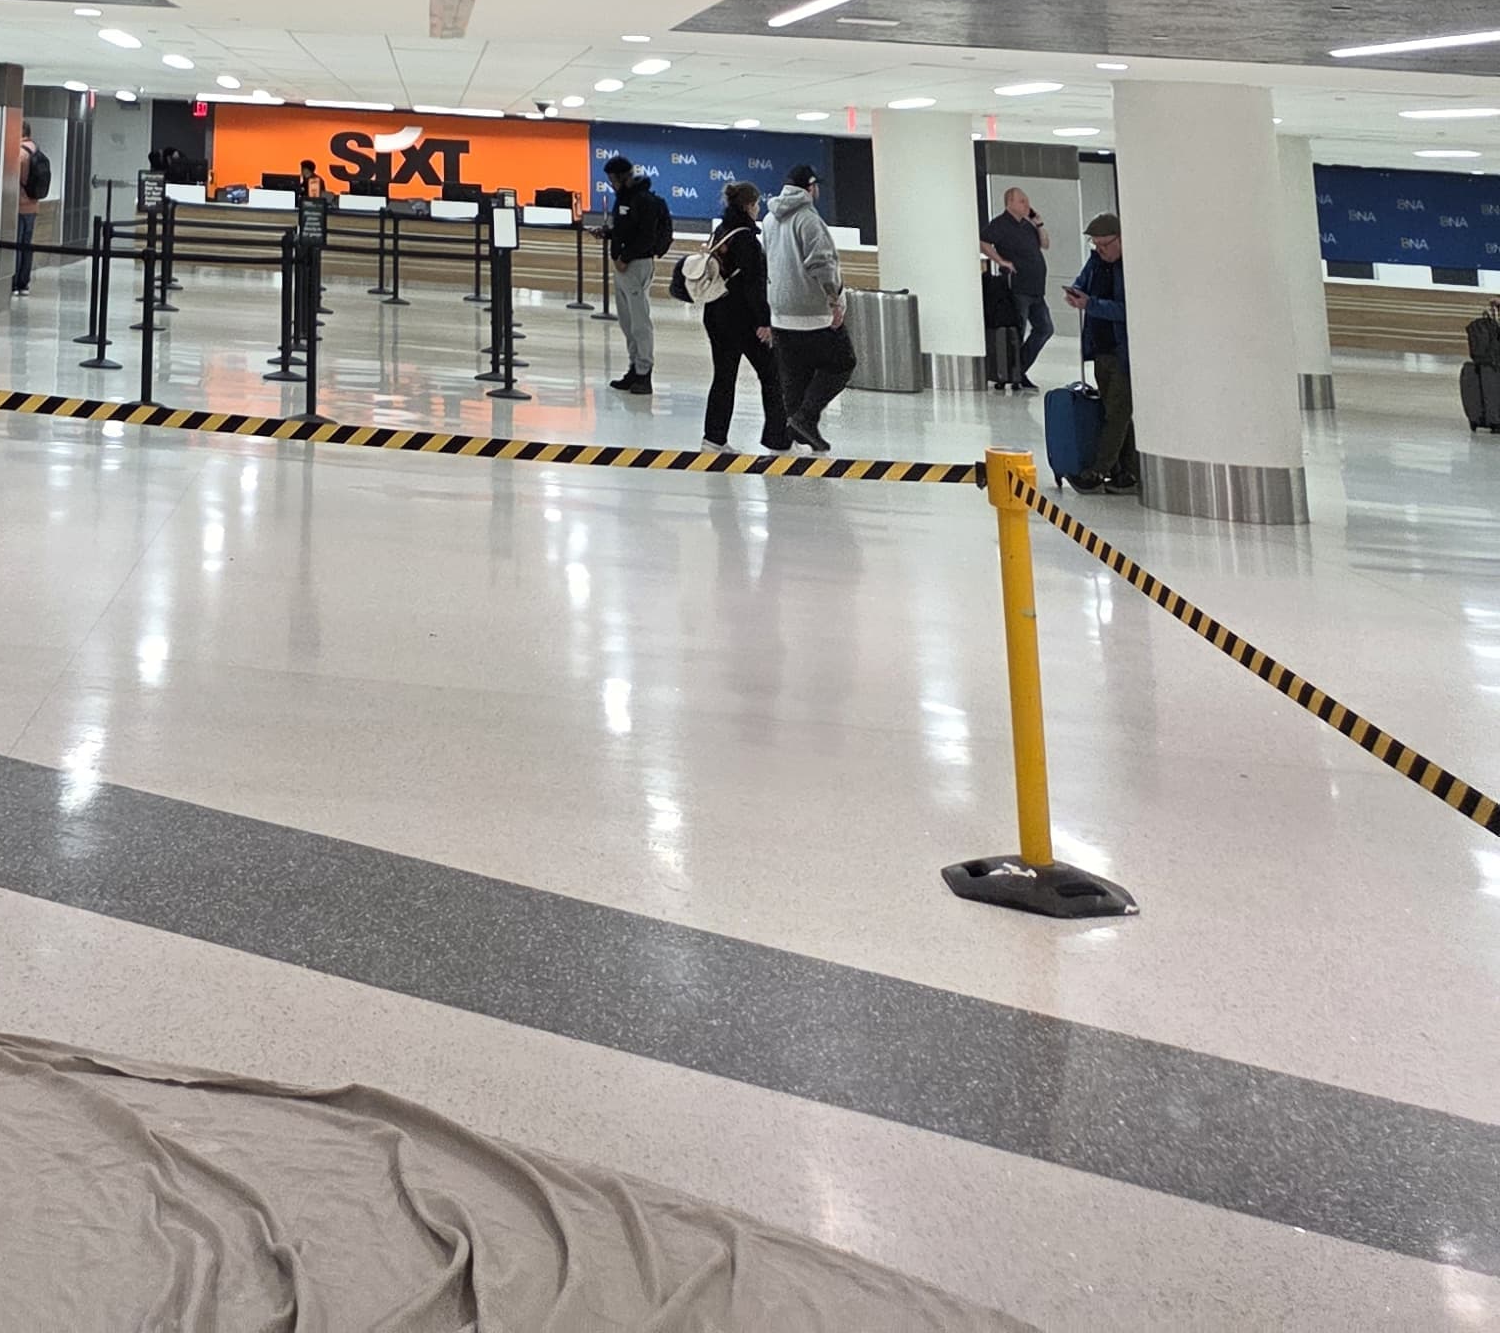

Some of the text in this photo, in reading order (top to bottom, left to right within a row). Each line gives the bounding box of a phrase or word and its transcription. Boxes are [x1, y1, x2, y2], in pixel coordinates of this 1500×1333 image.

[329, 126, 470, 186] SIXT
[671, 153, 697, 165] BNA
[747, 158, 773, 170] BNA
[633, 164, 660, 177] BNA
[709, 169, 736, 181] BNA
[672, 186, 698, 198] BNA
[1396, 198, 1425, 211] BNA
[1348, 209, 1377, 222] BNA
[1440, 216, 1468, 228] BNA
[1401, 237, 1429, 250] BNA
